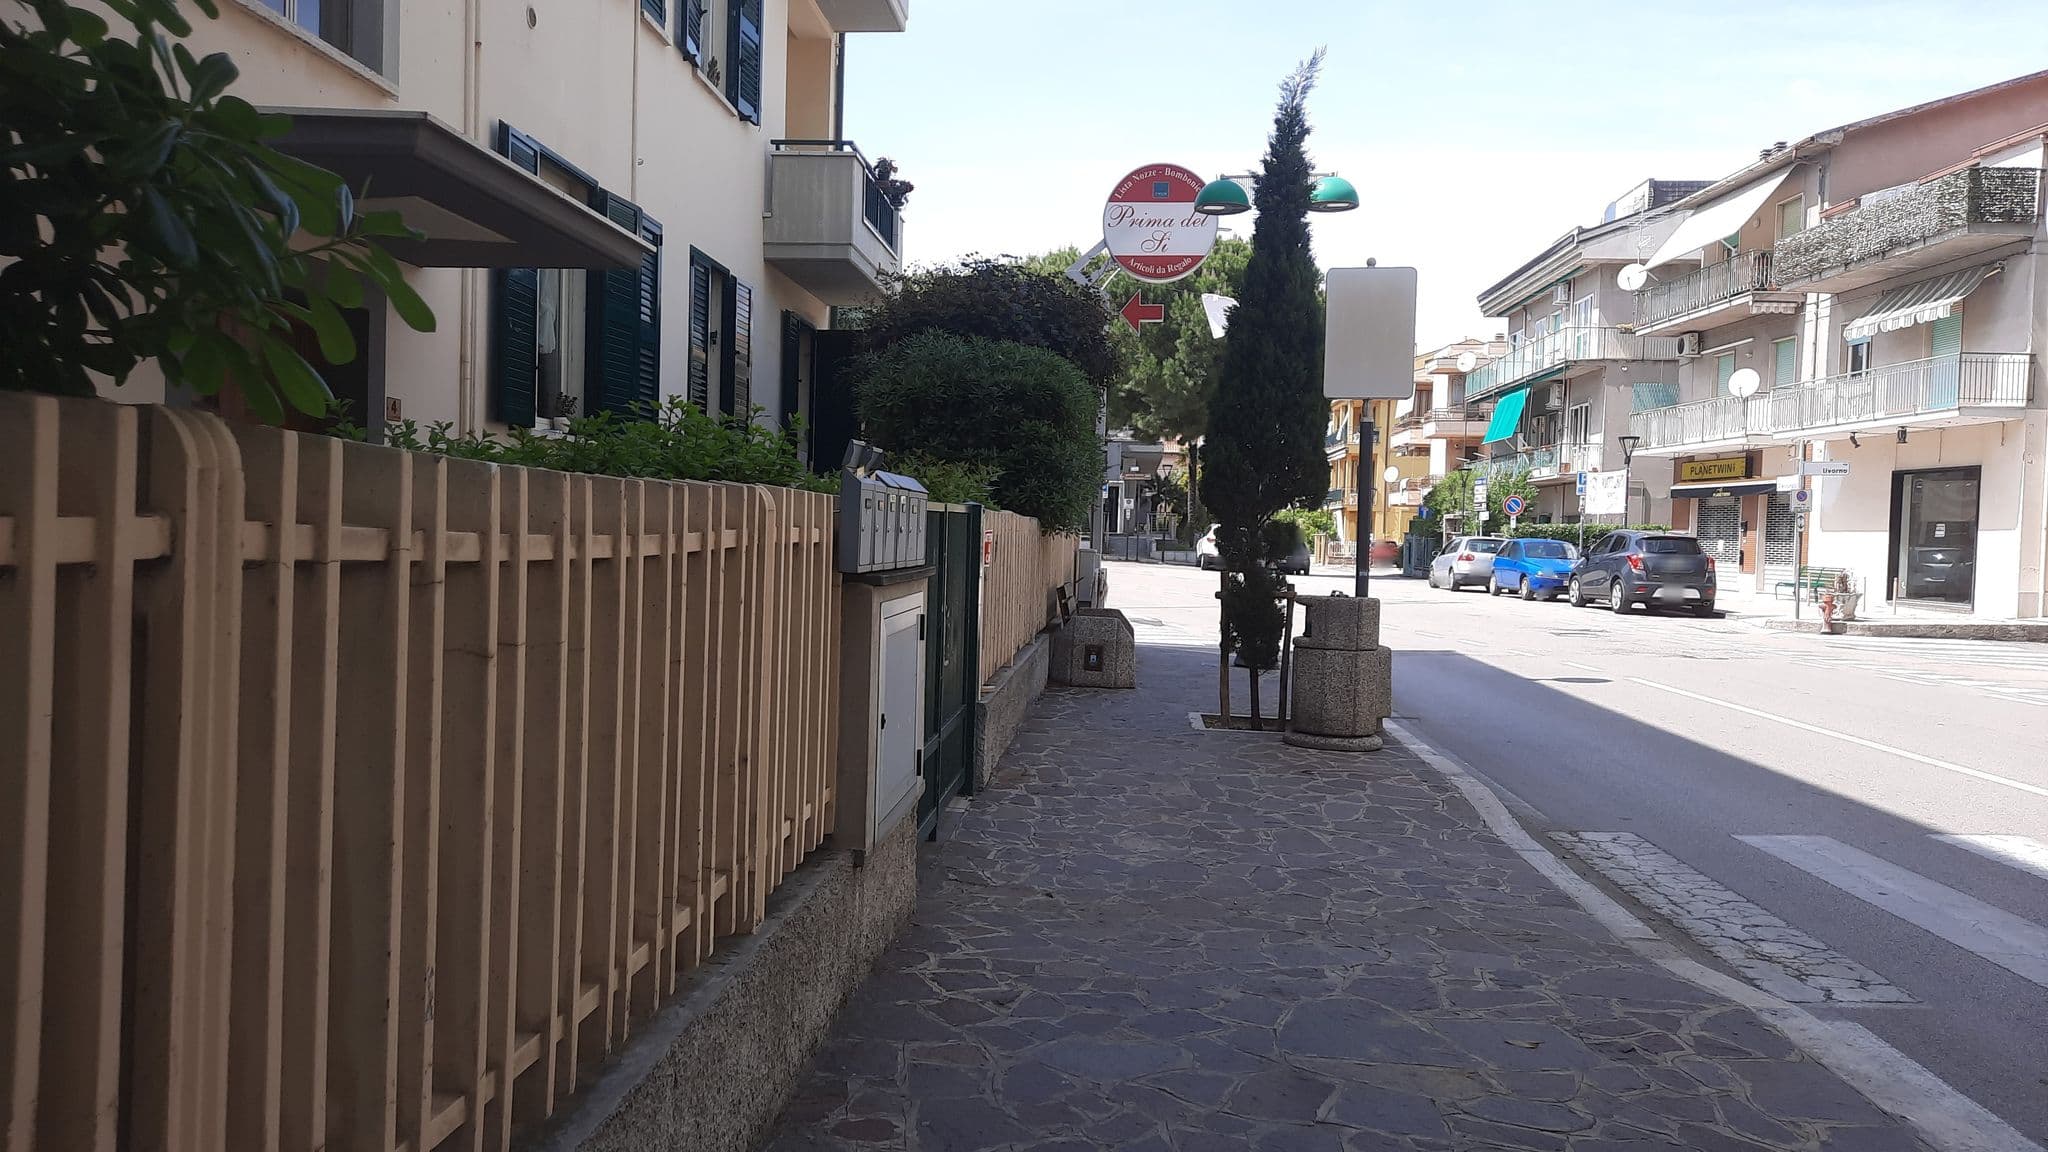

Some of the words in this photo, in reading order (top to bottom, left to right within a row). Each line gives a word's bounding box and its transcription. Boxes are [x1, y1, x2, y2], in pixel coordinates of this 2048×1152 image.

[1114, 182, 1133, 199] Lista
[1132, 169, 1157, 183] Nozze
[1107, 204, 1174, 228] Prima
[1128, 258, 1155, 274] Articoli
[1156, 265, 1166, 274] da
[1167, 257, 1192, 273] Regalo
[391, 399, 397, 415] 4
